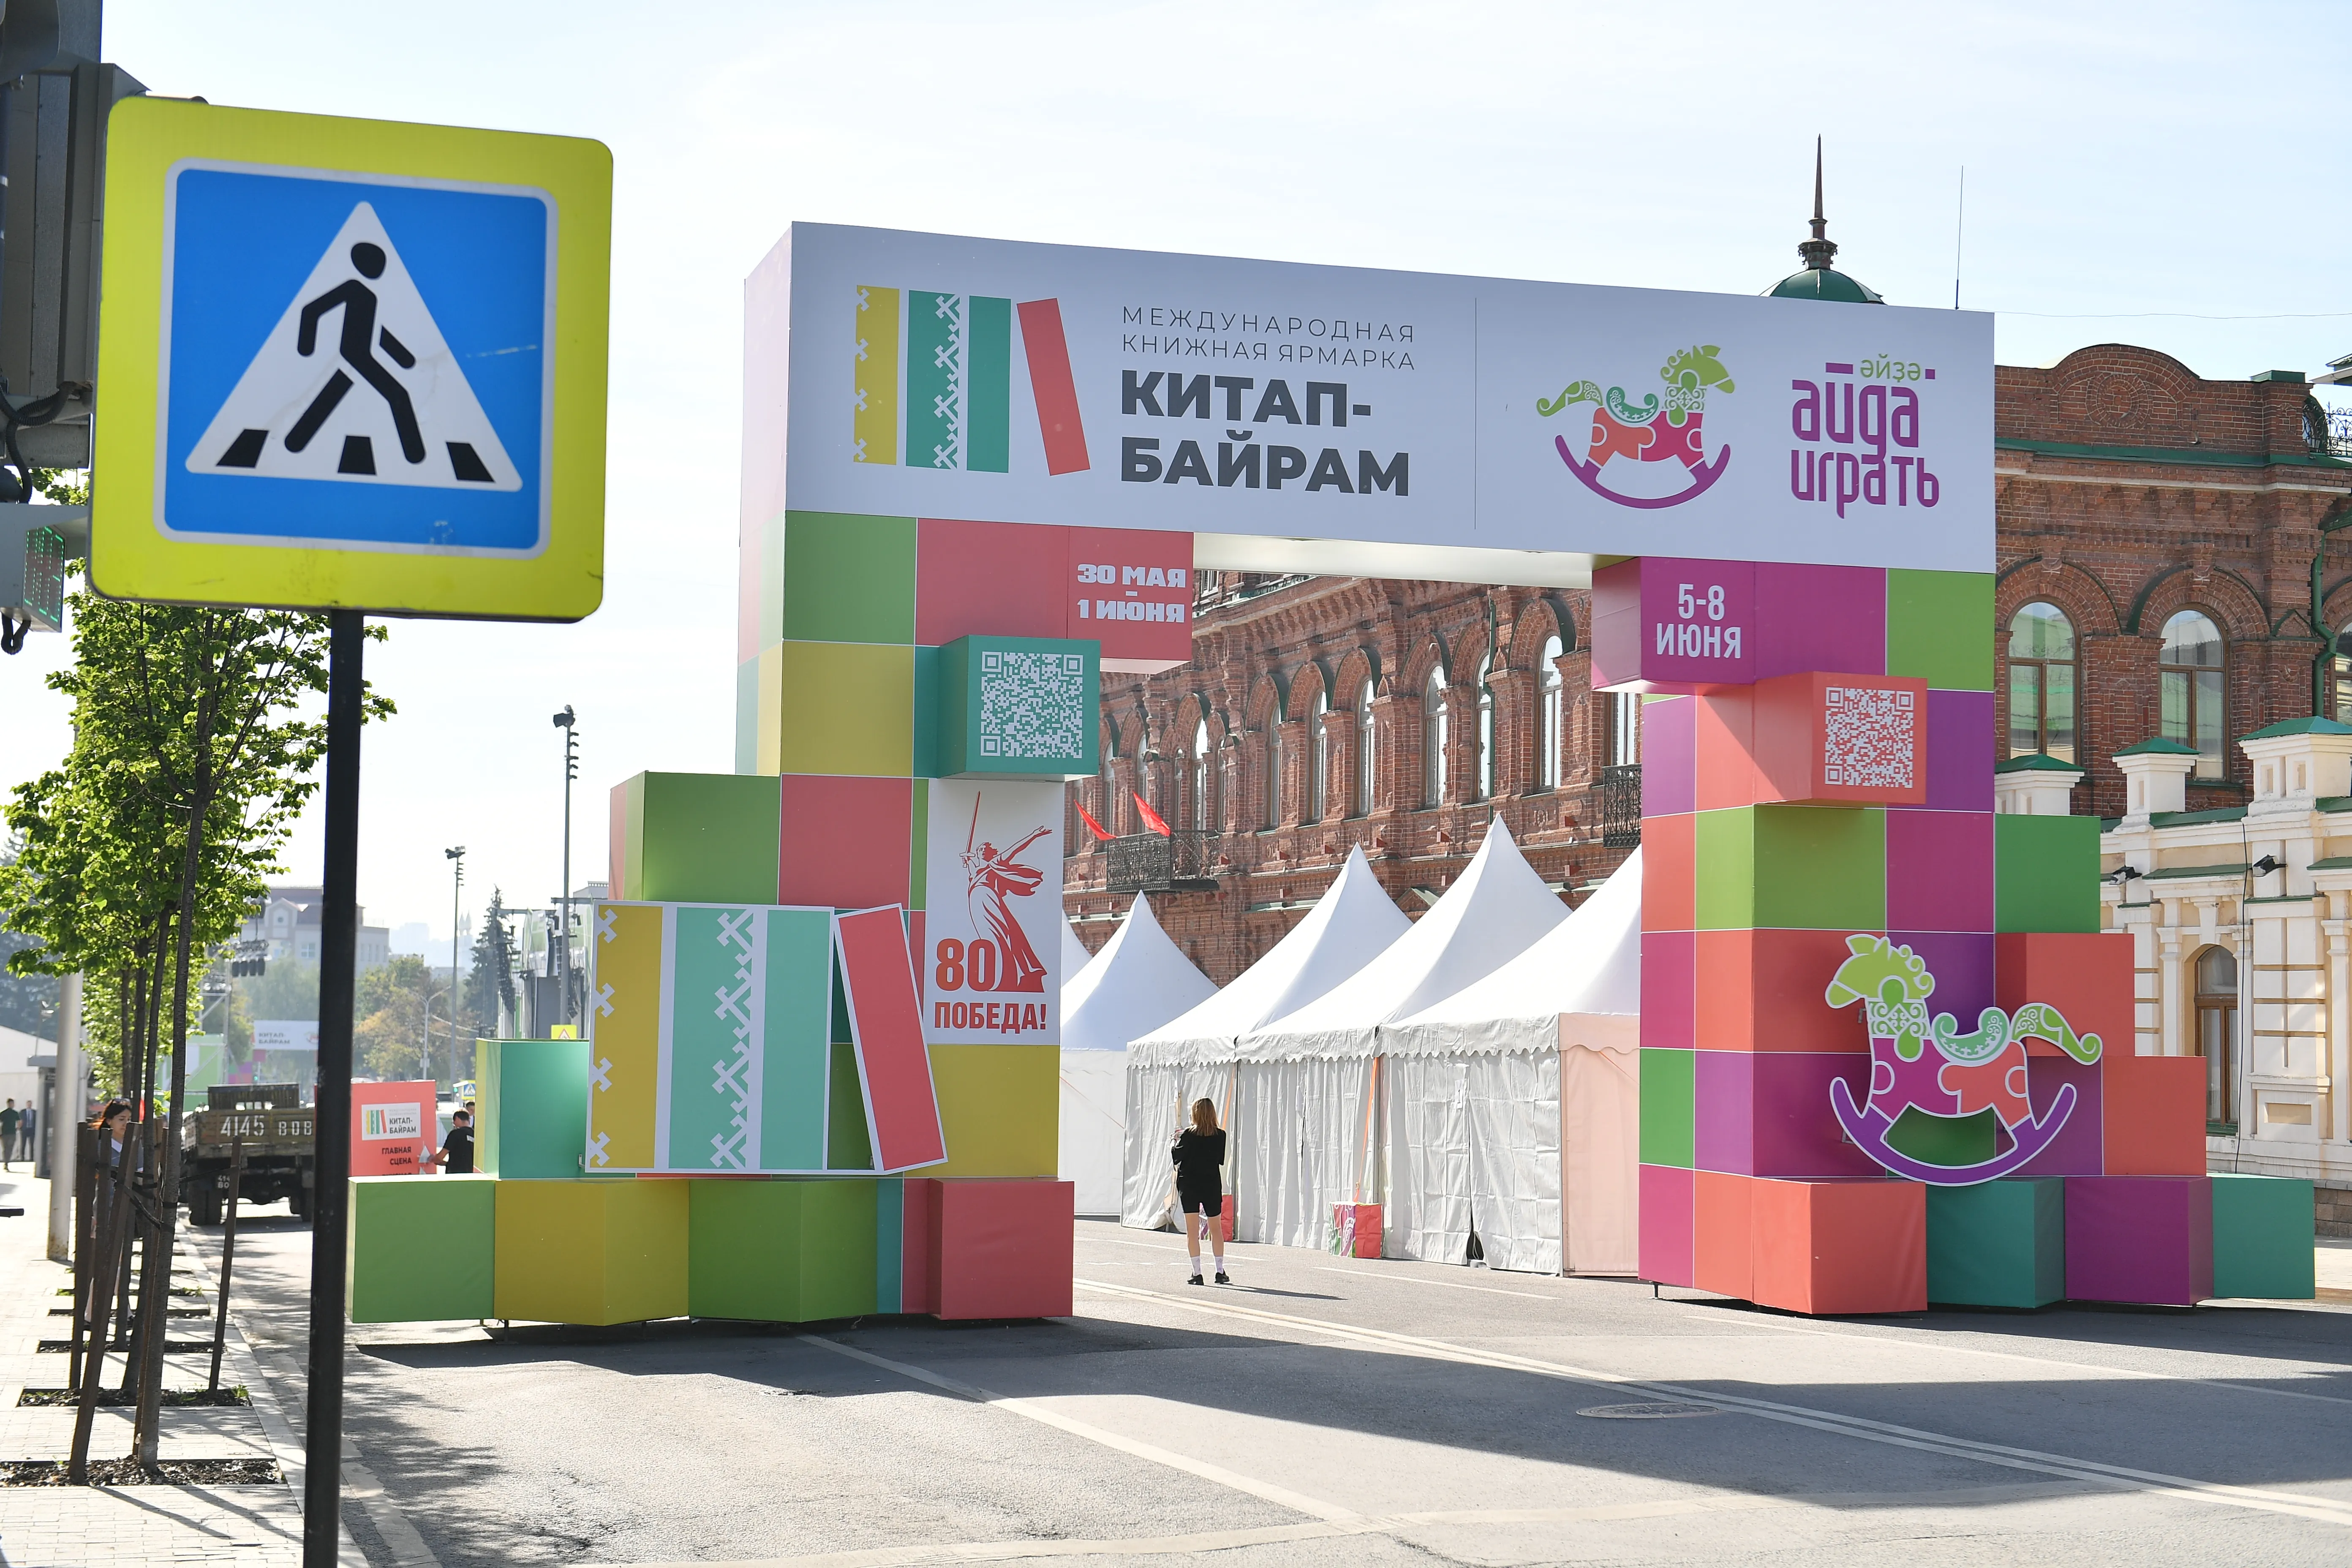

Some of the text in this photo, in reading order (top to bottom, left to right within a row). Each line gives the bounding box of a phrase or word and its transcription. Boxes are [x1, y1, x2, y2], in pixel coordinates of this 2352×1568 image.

[1123, 306, 1413, 343] МЕЖДУНАРОДНАЯ
[1123, 334, 1415, 370] КНИЖНАЯ ЯРМАРКА
[1122, 370, 1371, 427] КИТАП-
[1121, 429, 1409, 497] БАЙРАМ
[1791, 449, 1939, 519] играть
[1077, 564, 1186, 588] 30 МАЯ
[1077, 599, 1185, 623] 1 ИЮНЯ
[1678, 583, 1725, 621] 5-8
[1655, 623, 1741, 659] ИЮНЯ
[935, 938, 996, 992] 80
[934, 1002, 1047, 1034] ПОБЕДА!
[220, 1116, 265, 1136] 4145
[389, 1125, 416, 1134] БАЙРАМ
[382, 1146, 411, 1154] ГЛАВНАЯ
[390, 1157, 412, 1165] СЦЕНА
